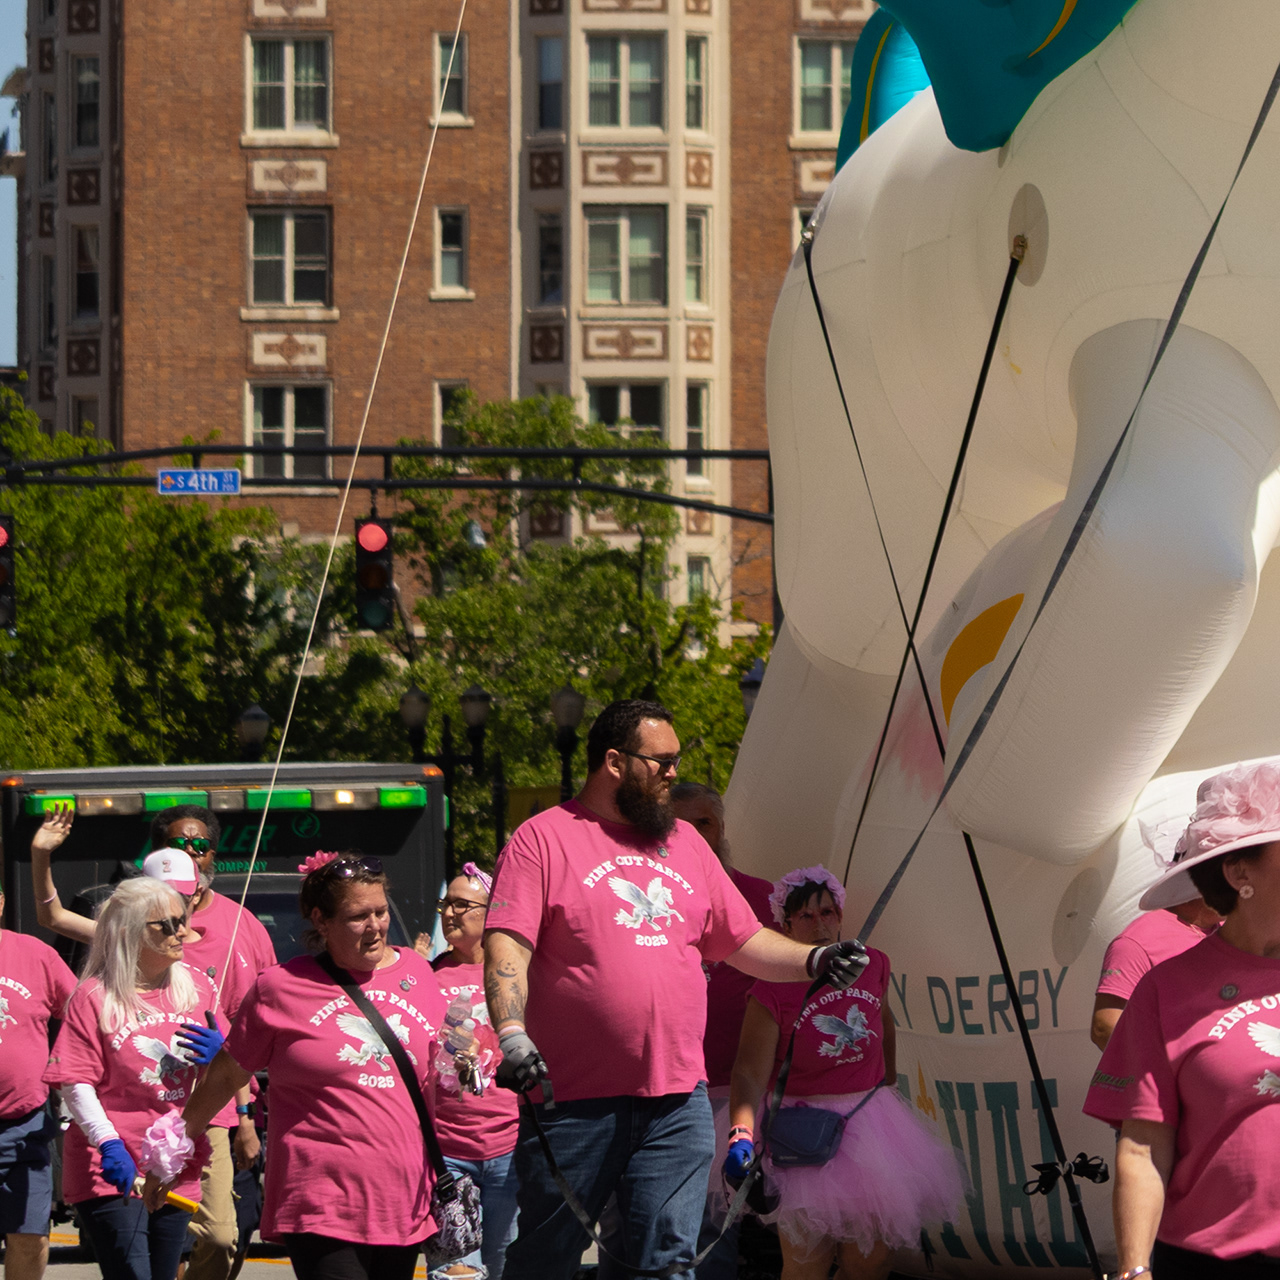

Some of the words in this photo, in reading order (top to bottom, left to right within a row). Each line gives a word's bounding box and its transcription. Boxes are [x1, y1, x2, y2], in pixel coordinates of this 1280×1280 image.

[177, 475, 185, 489] S
[188, 473, 218, 491] 4th
[583, 860, 616, 888] PINK
[615, 855, 644, 867] OUT
[647, 858, 695, 895] PARTY!
[635, 934, 669, 947] 2025
[0, 976, 32, 999] ARTY!
[820, 990, 843, 1005] OUT
[926, 966, 1069, 1035] DERBY
[310, 995, 350, 1026] PINK
[364, 990, 387, 1002] UT
[389, 992, 436, 1036] PARTY!
[1208, 1000, 1260, 1040] PINK
[358, 1073, 395, 1088] 2025
[158, 1087, 186, 1101] 2025
